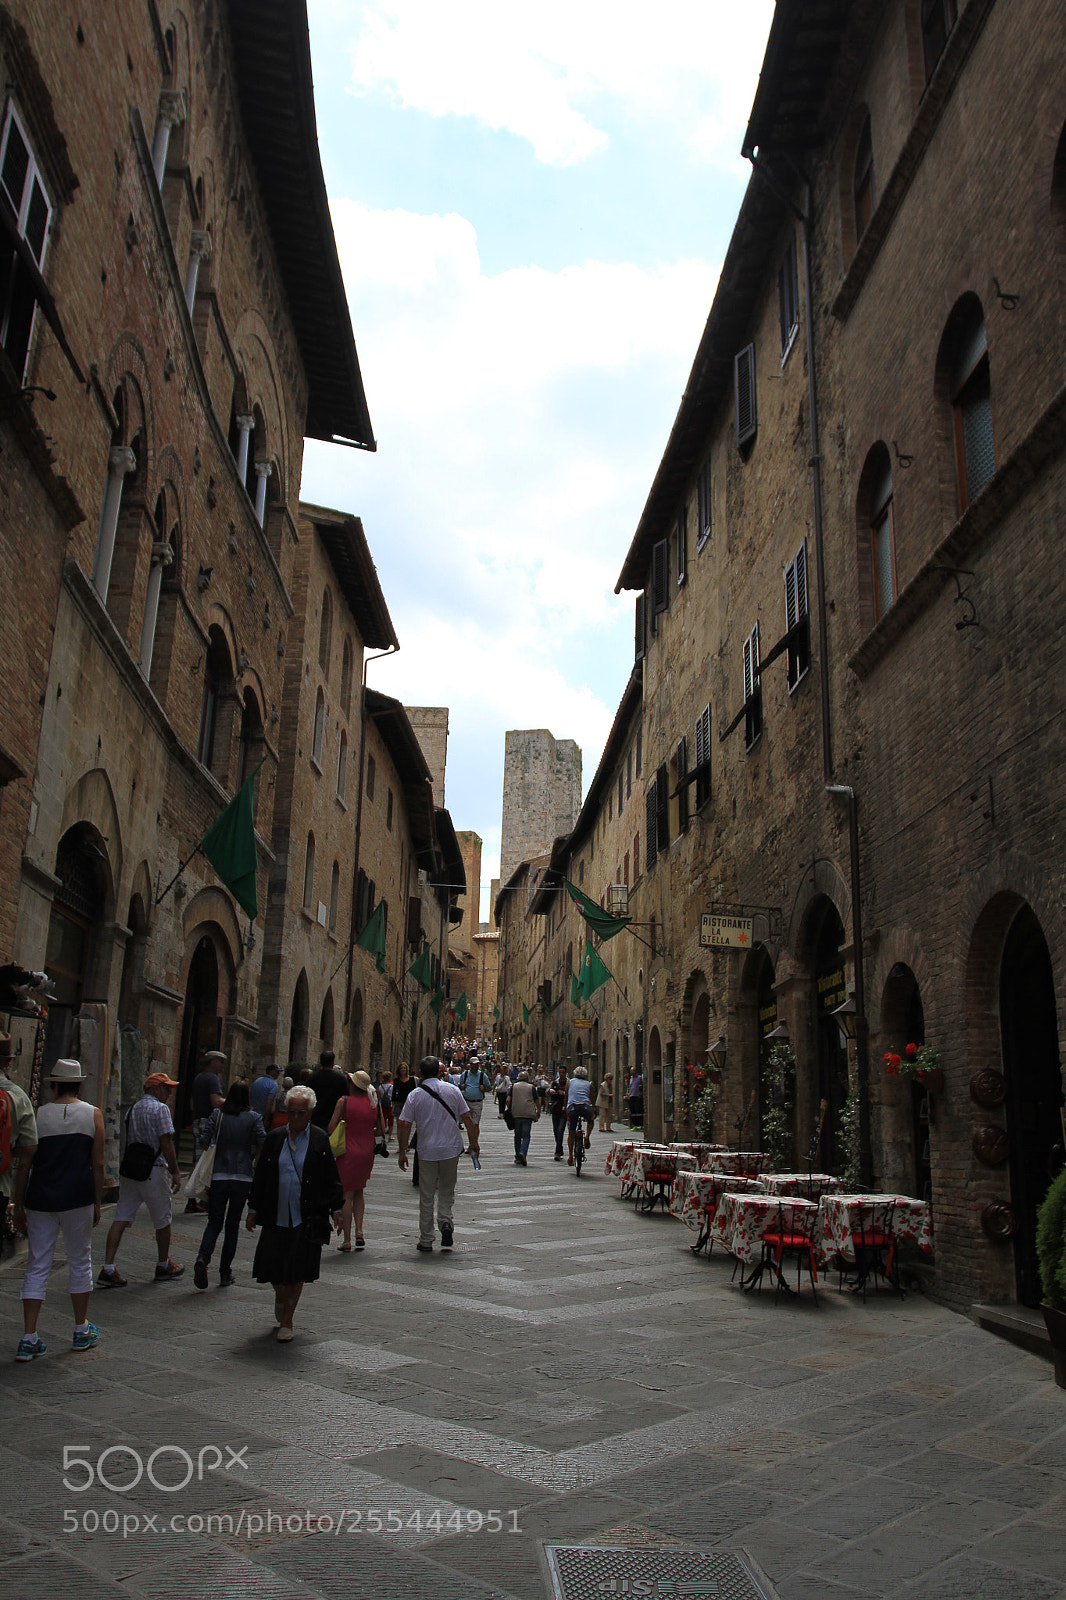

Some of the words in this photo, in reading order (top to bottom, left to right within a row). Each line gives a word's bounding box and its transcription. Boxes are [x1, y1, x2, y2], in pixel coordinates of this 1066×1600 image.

[703, 916, 751, 930] RISTORANTE
[711, 928, 721, 936] LA
[702, 935, 730, 945] STELLA
